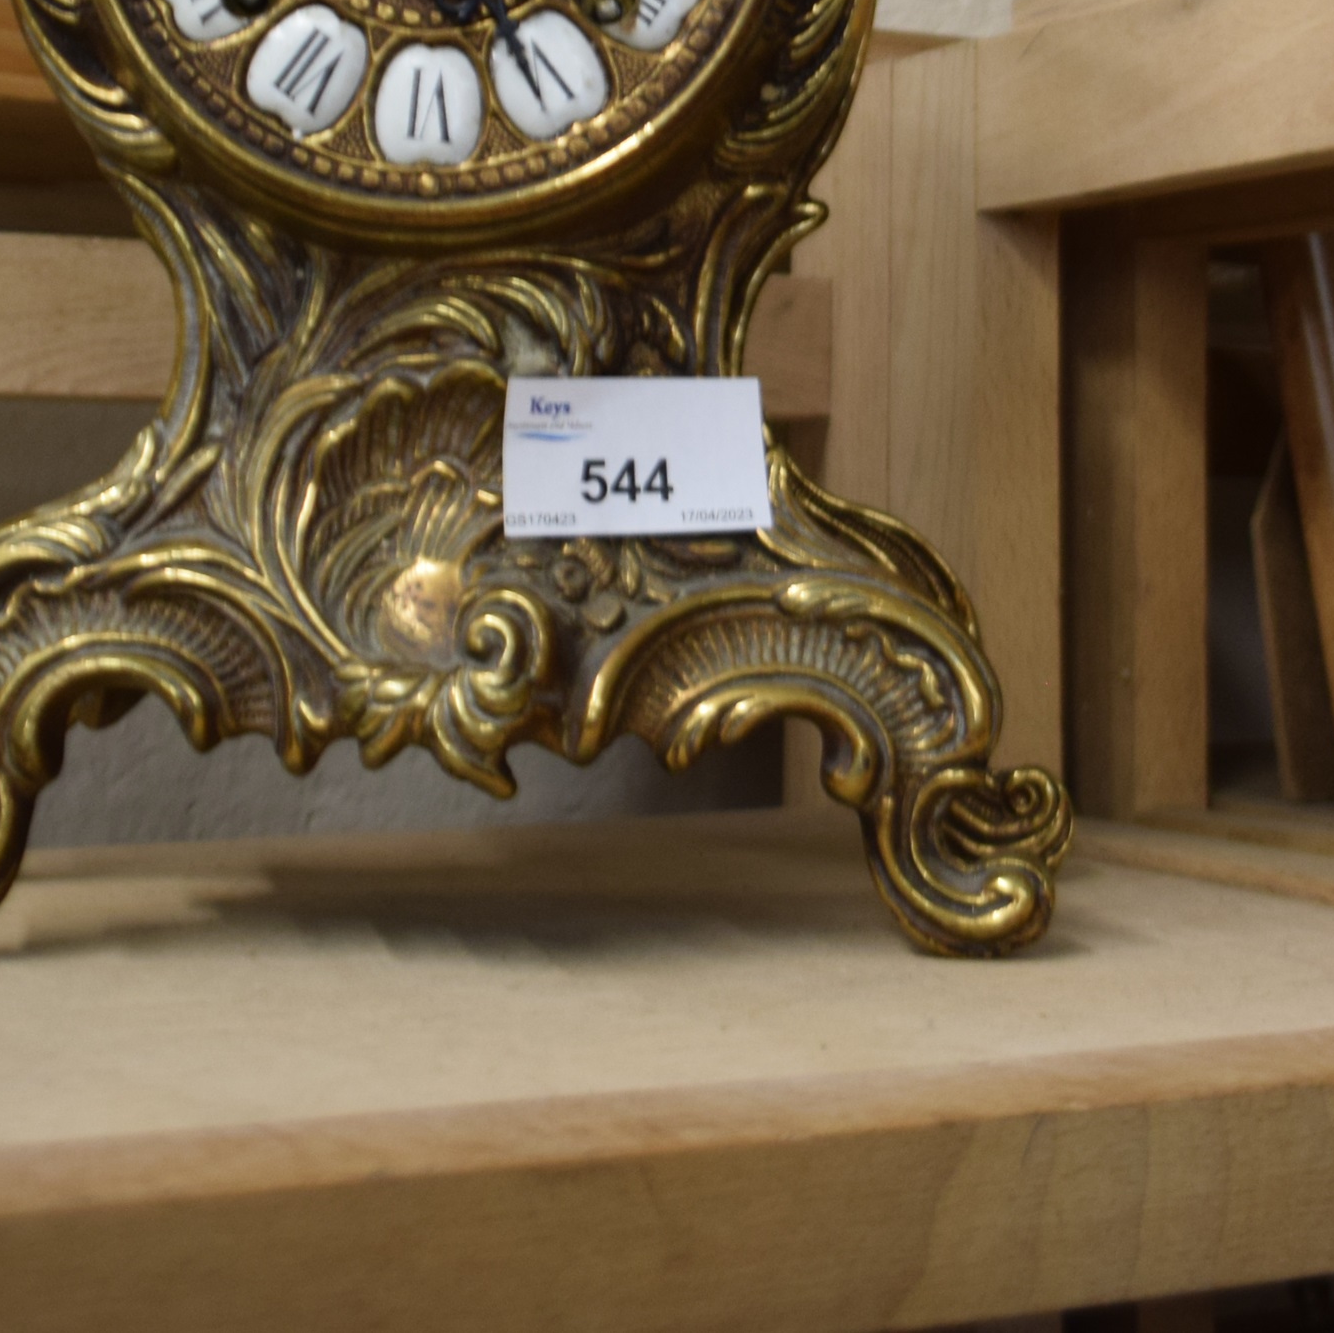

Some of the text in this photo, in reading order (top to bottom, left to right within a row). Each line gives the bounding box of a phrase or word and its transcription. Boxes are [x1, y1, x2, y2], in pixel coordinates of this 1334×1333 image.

[407, 66, 450, 145] VI
[530, 395, 572, 421] Keys
[581, 457, 674, 504] 544
[681, 507, 755, 523] 17/04/2023
